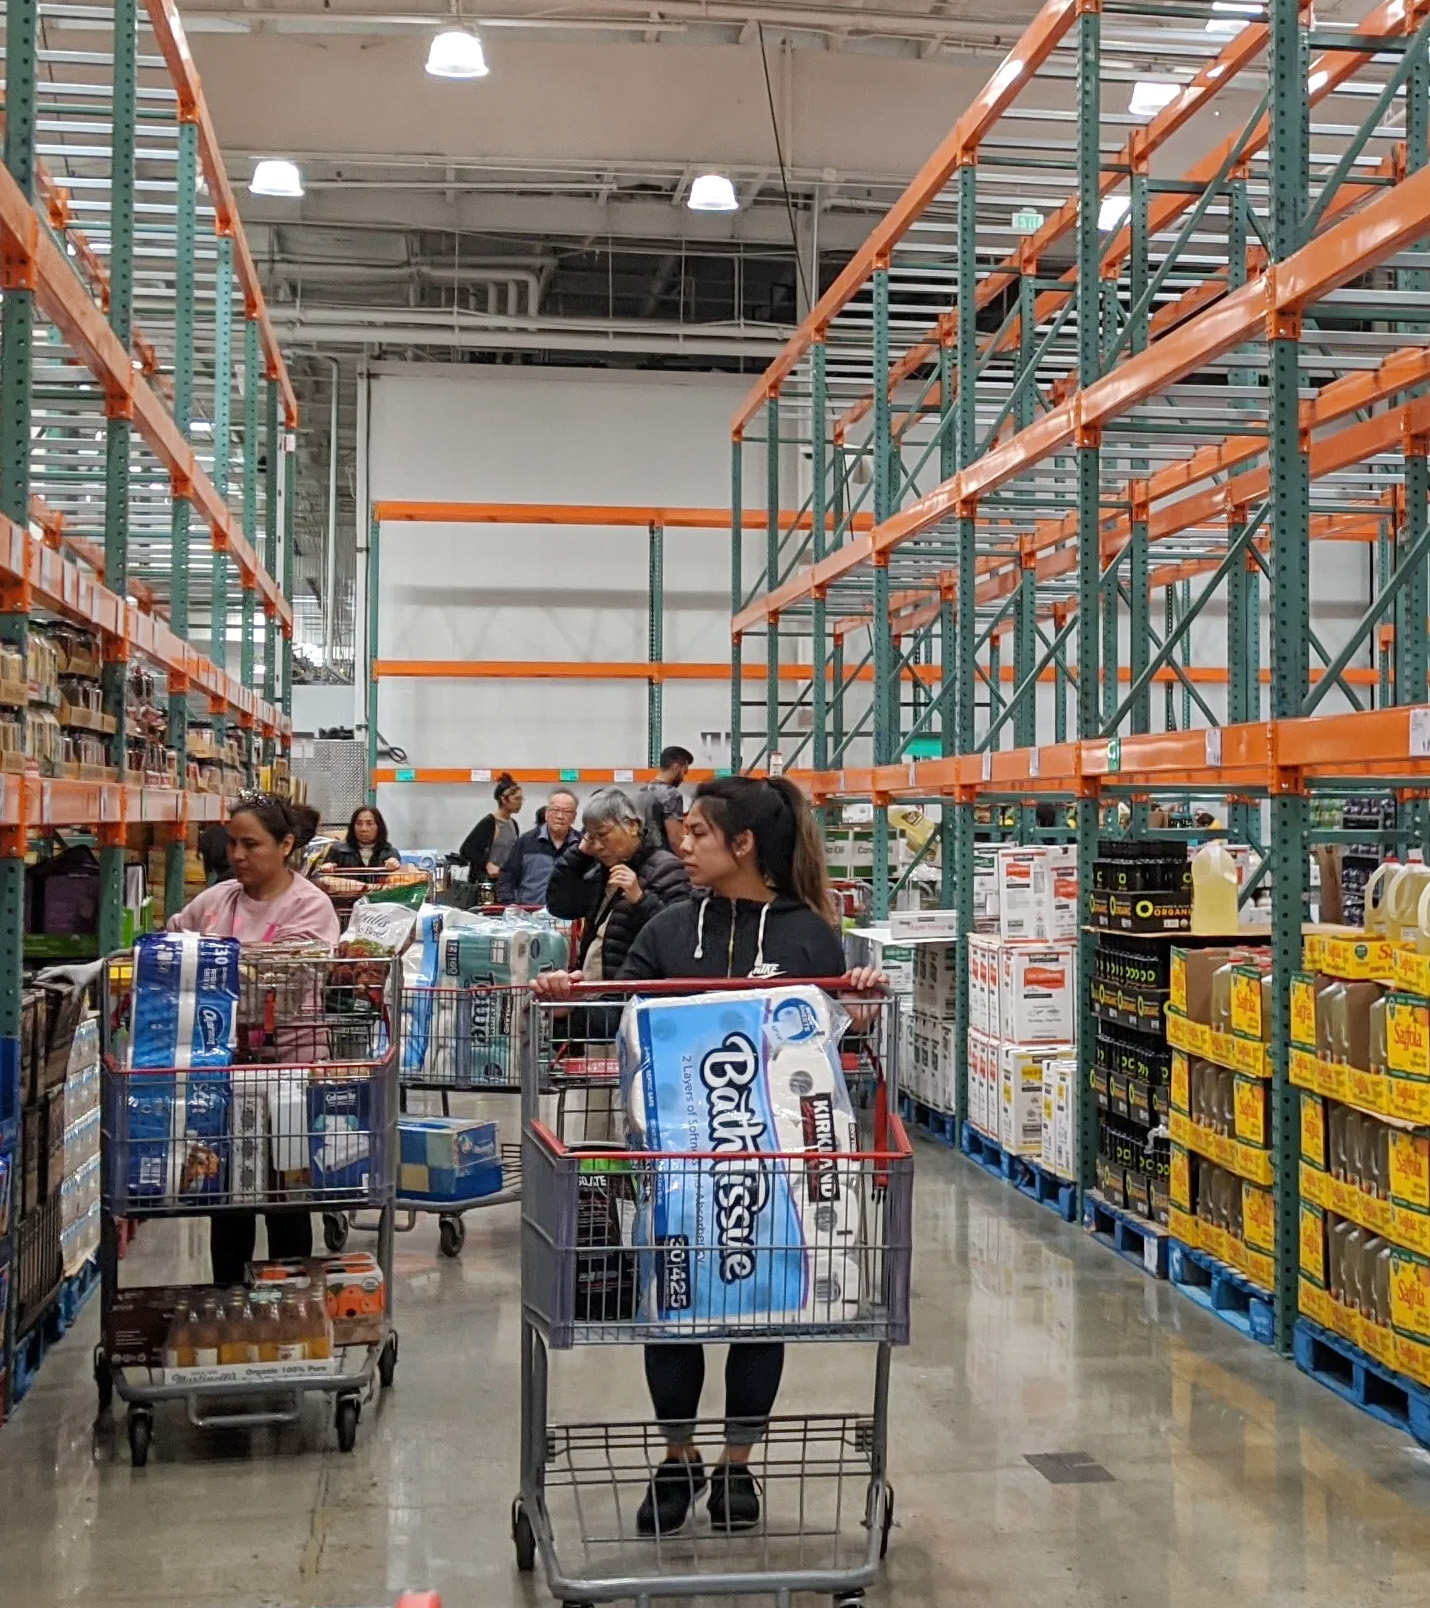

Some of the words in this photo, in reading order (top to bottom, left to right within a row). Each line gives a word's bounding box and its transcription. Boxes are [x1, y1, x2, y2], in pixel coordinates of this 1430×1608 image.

[1154, 908, 1191, 916] ORGANI
[752, 963, 780, 975] NIKE
[1394, 1022, 1422, 1051] Saffola
[682, 1066, 695, 1102] Layers
[700, 1031, 768, 1153] Bath
[687, 1105, 698, 1116] of
[688, 1119, 701, 1167] Softns
[711, 1153, 770, 1285] Tissue
